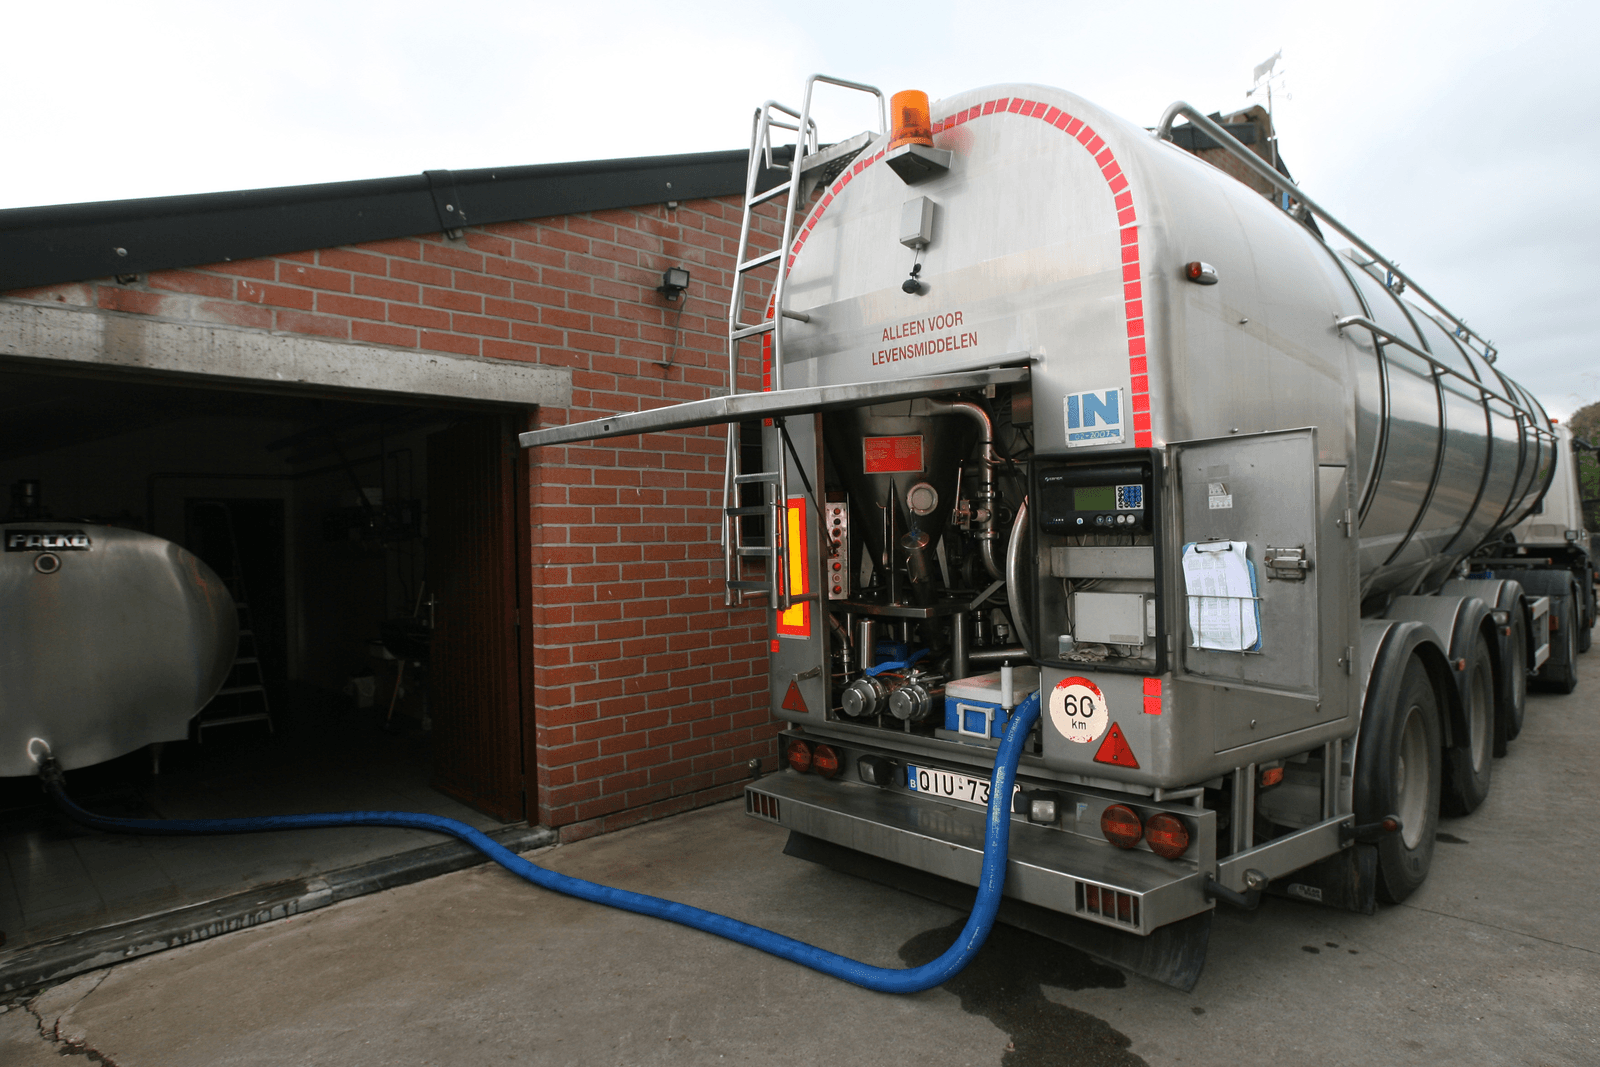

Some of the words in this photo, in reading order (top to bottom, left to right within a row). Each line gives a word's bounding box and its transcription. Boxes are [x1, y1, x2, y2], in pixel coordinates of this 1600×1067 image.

[882, 319, 925, 342] ALLEEN
[928, 311, 963, 331] VOOR
[872, 331, 978, 366] LEVENSMIDDELEN
[1067, 390, 1119, 429] IN
[9, 534, 90, 547] PACKO
[1064, 694, 1094, 718] 60
[1071, 718, 1087, 730] km
[910, 779, 917, 788] B
[920, 770, 990, 804] QIU-73
